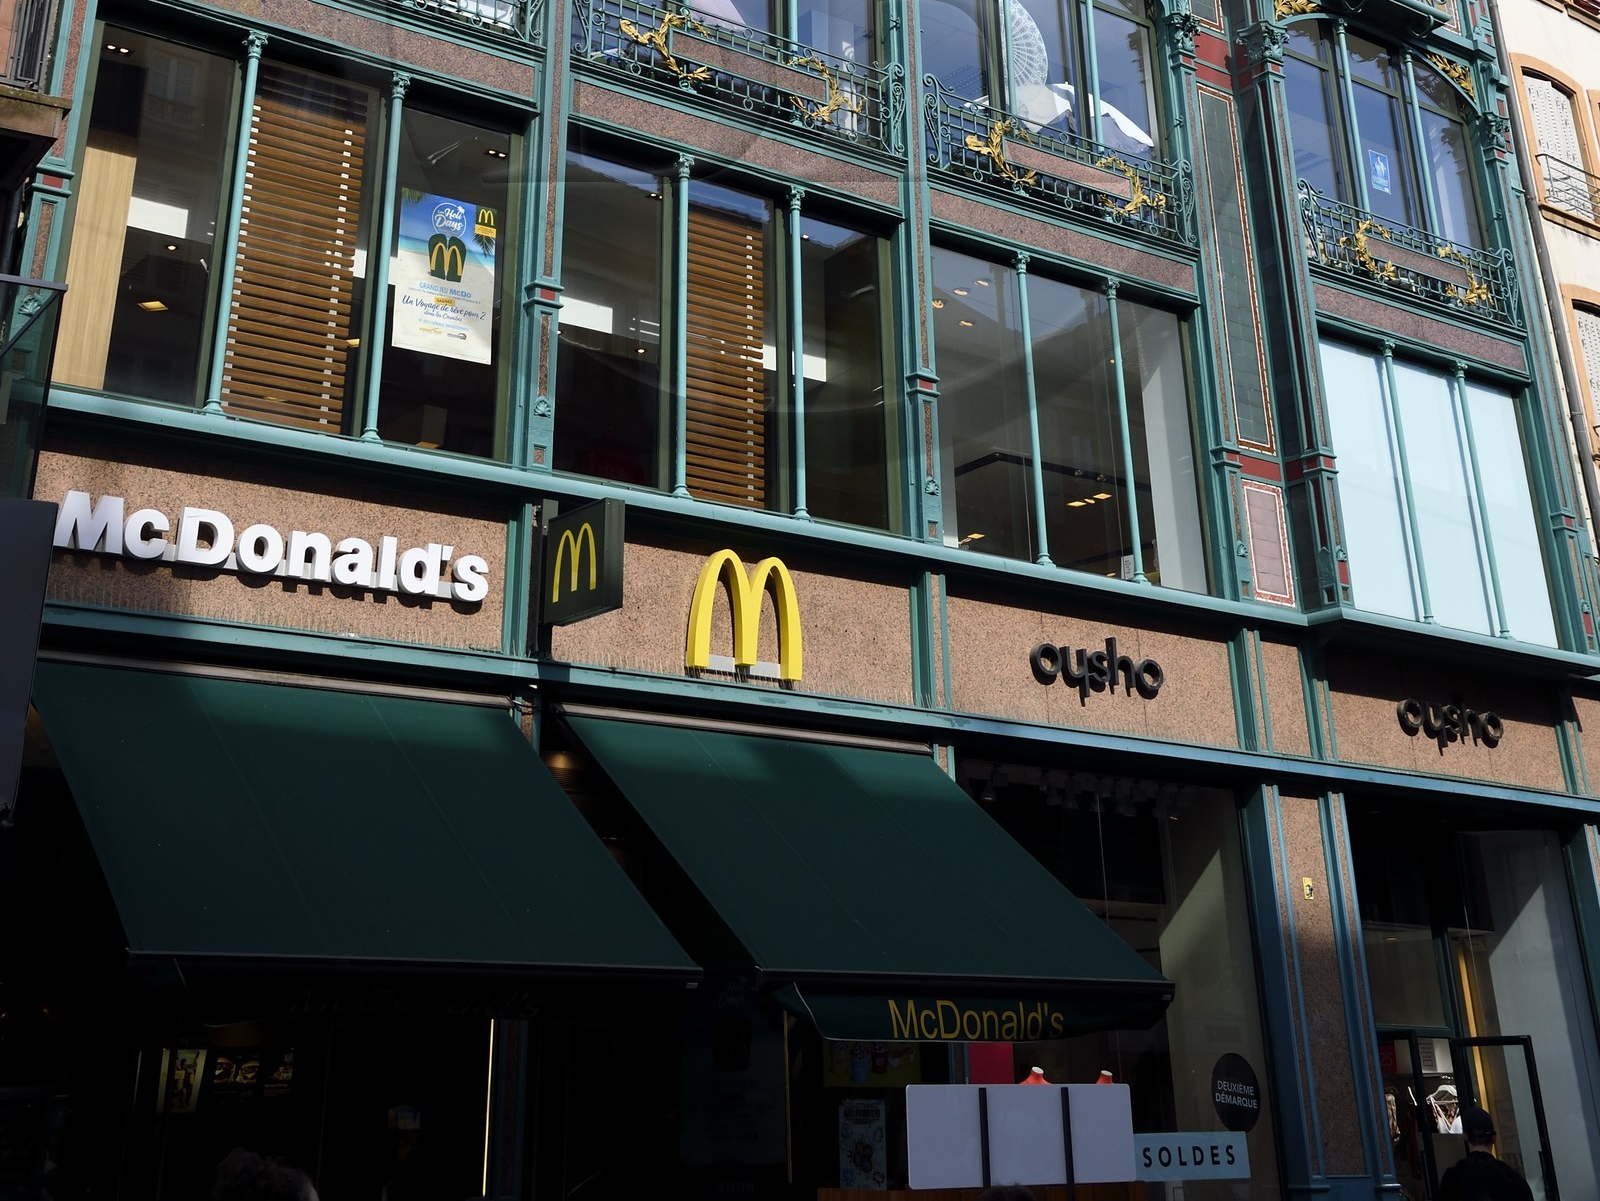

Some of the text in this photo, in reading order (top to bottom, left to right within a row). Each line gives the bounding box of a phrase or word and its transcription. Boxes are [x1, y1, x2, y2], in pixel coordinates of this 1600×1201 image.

[434, 213, 464, 231] Days
[419, 282, 438, 292] GRAND
[449, 288, 472, 298] McDo
[402, 294, 414, 305] Un
[415, 298, 440, 311] Voyage
[440, 302, 450, 312] de
[479, 311, 487, 321] 2
[53, 490, 489, 602] McDonald's
[1029, 637, 1164, 698] oysho
[1397, 697, 1503, 748] oysho
[888, 999, 1065, 1040] McDonald's
[1215, 1091, 1258, 1109] DÉMARQUE
[1217, 1080, 1255, 1096] DEUXIÈME
[1142, 1144, 1235, 1168] SOLDES
